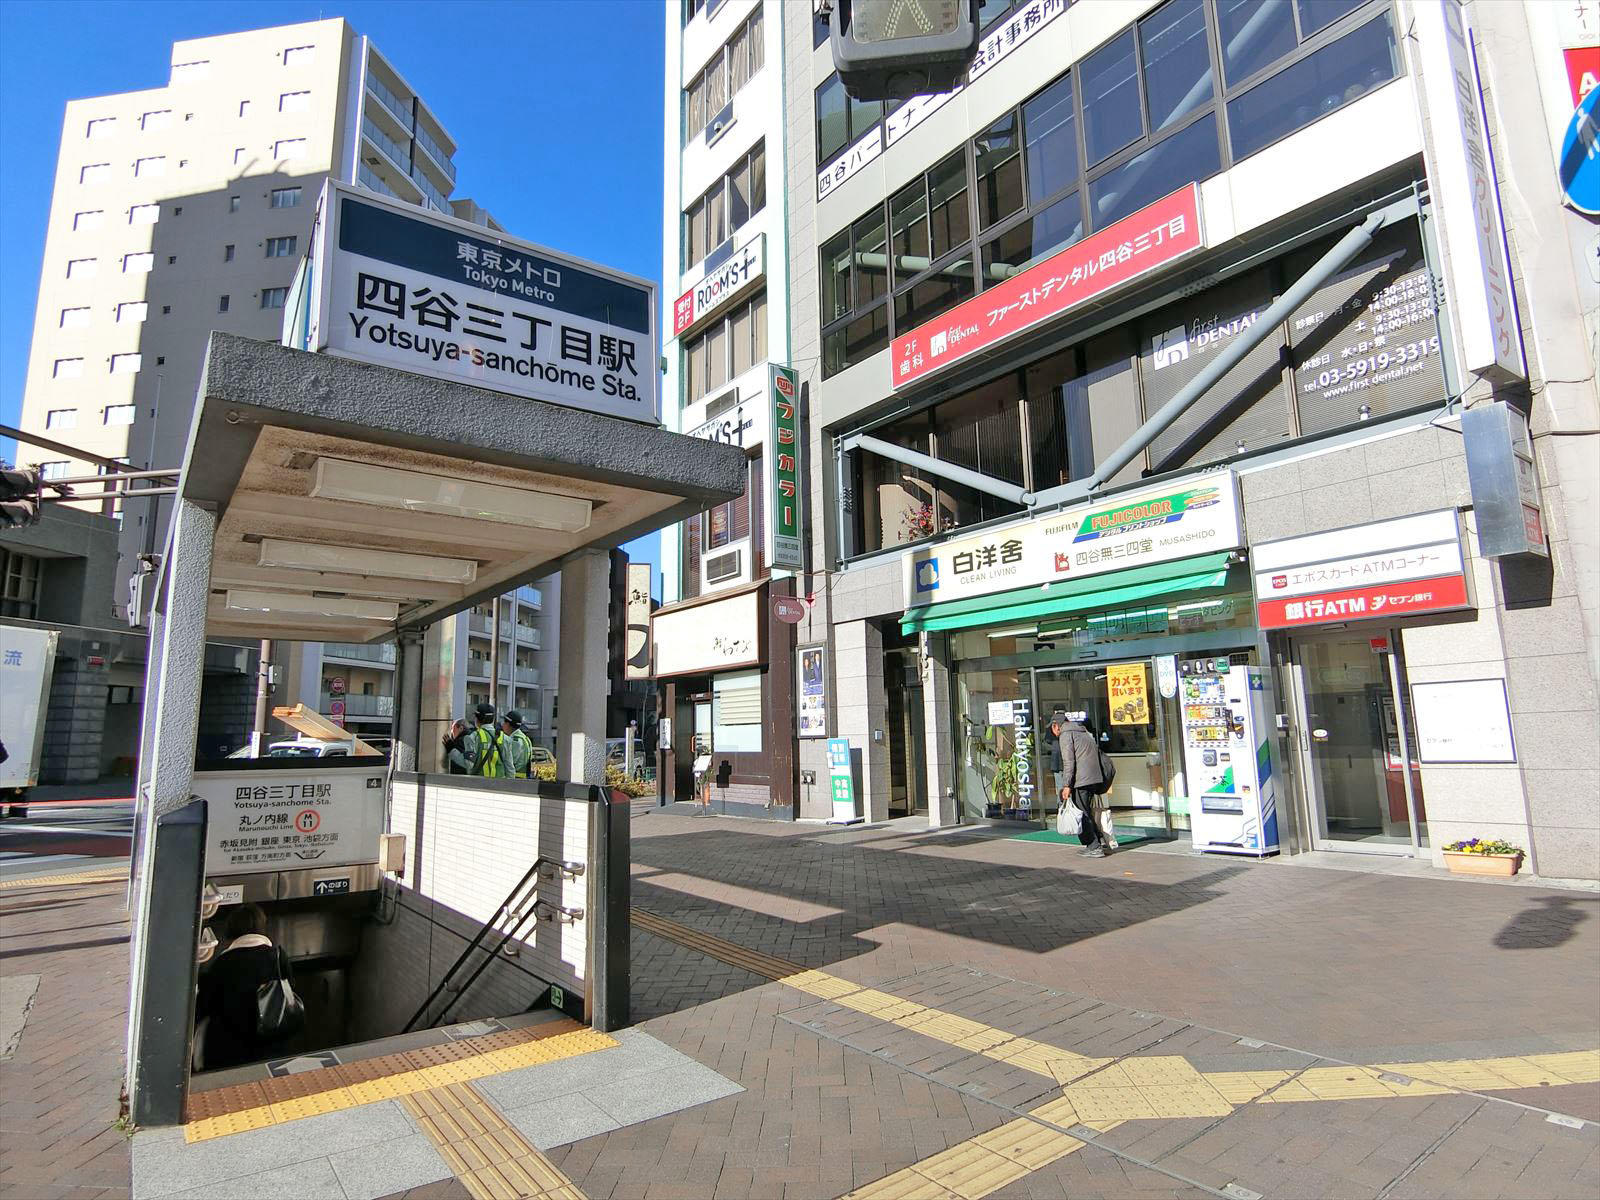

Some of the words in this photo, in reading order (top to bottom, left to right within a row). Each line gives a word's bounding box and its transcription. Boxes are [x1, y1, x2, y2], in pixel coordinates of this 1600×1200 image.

[456, 240, 561, 288] 東京メトロ
[987, 214, 1186, 327] ファーストデンタル四谷三丁目
[464, 265, 508, 290] Tokyo
[512, 278, 555, 302] Metro
[357, 272, 639, 377] 四谷三丁目駅
[678, 311, 691, 329] 2F
[1189, 313, 1219, 343] first
[1354, 320, 1367, 332] 土
[951, 323, 979, 345] DENTAL
[904, 340, 918, 357] 2F
[899, 351, 924, 376] 歯科
[1302, 353, 1331, 371] 休診日
[602, 375, 641, 402] Sta.
[1323, 361, 1424, 398] www.firstdental.net
[777, 402, 795, 526] フジカラー
[1091, 500, 1172, 530] FUJICOLOR
[1045, 521, 1079, 536] FUJIFILM
[1159, 529, 1216, 547] MUSASHIDO
[1076, 538, 1153, 566] 四谷無三四堂
[960, 572, 986, 585] CLEAN
[989, 566, 1017, 580] LIVING
[1389, 592, 1432, 605] セブン銀行
[1284, 597, 1365, 620] 銀行ATM
[4, 650, 22, 666] 流
[1112, 675, 1142, 687] カメラ
[1112, 687, 1143, 697] 買います
[1013, 700, 1035, 809] Hakuyosha
[236, 784, 331, 800] 四谷三丁目駅
[370, 780, 377, 788] 4
[240, 813, 288, 826] 丸ノ内線
[220, 838, 258, 849] 赤坂見附
[261, 836, 280, 846] 銀座
[283, 835, 301, 844] 東京
[303, 833, 339, 844] 池袋方面
[328, 881, 348, 889] のぼり
